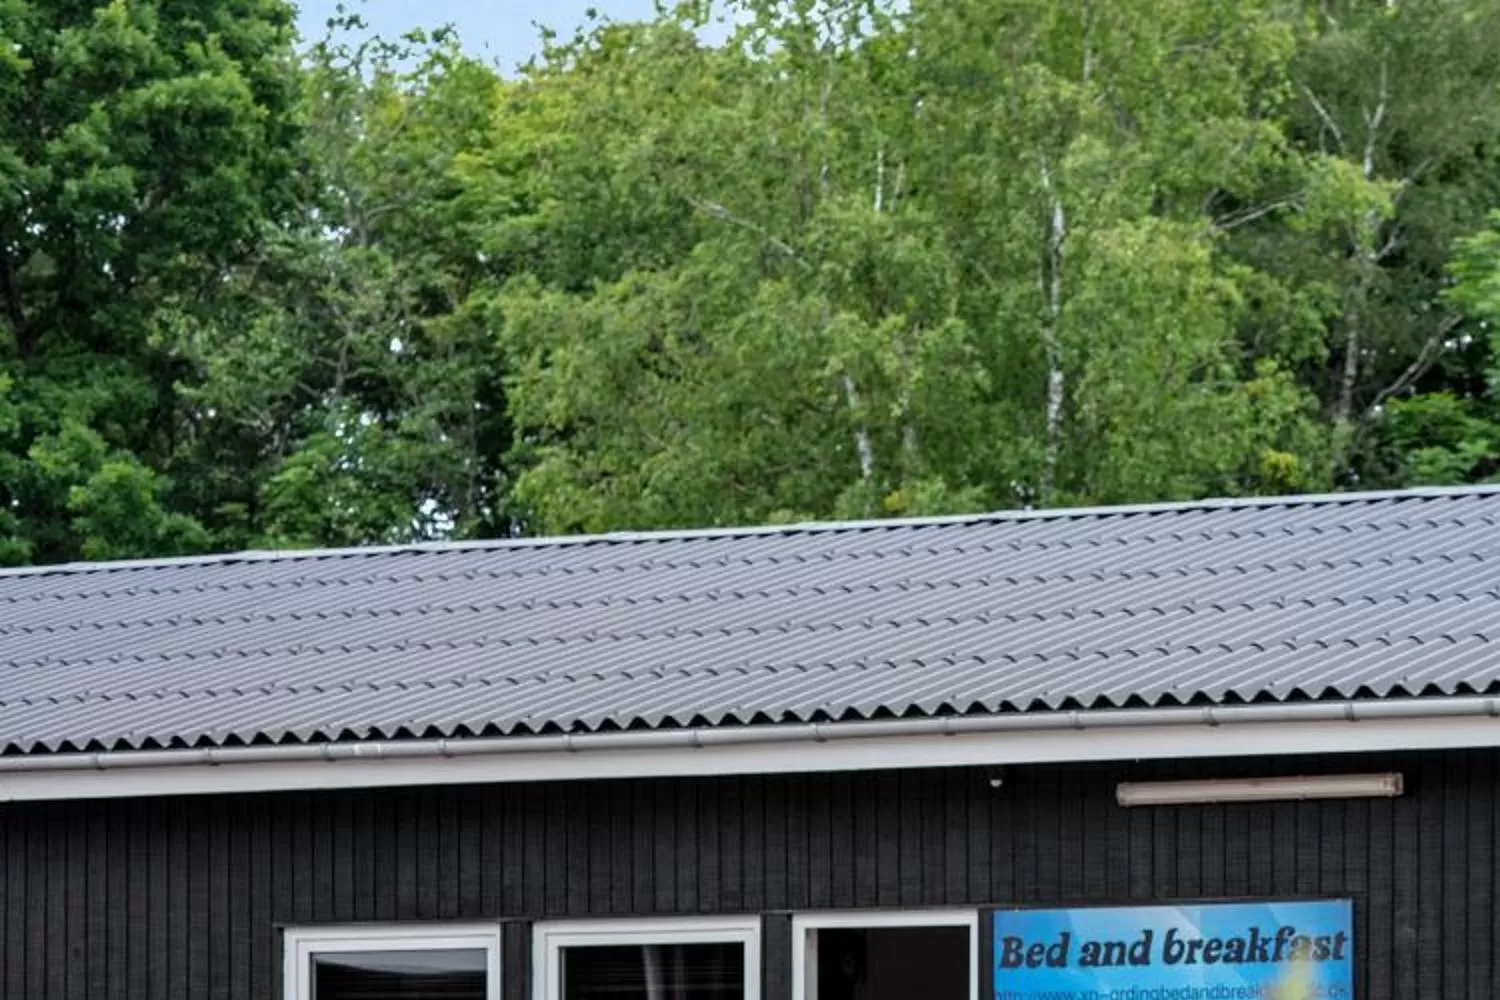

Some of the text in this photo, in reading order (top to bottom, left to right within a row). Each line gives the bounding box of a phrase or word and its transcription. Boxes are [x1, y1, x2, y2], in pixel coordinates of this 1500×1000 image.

[1000, 926, 1348, 969] Bed and breakfast
